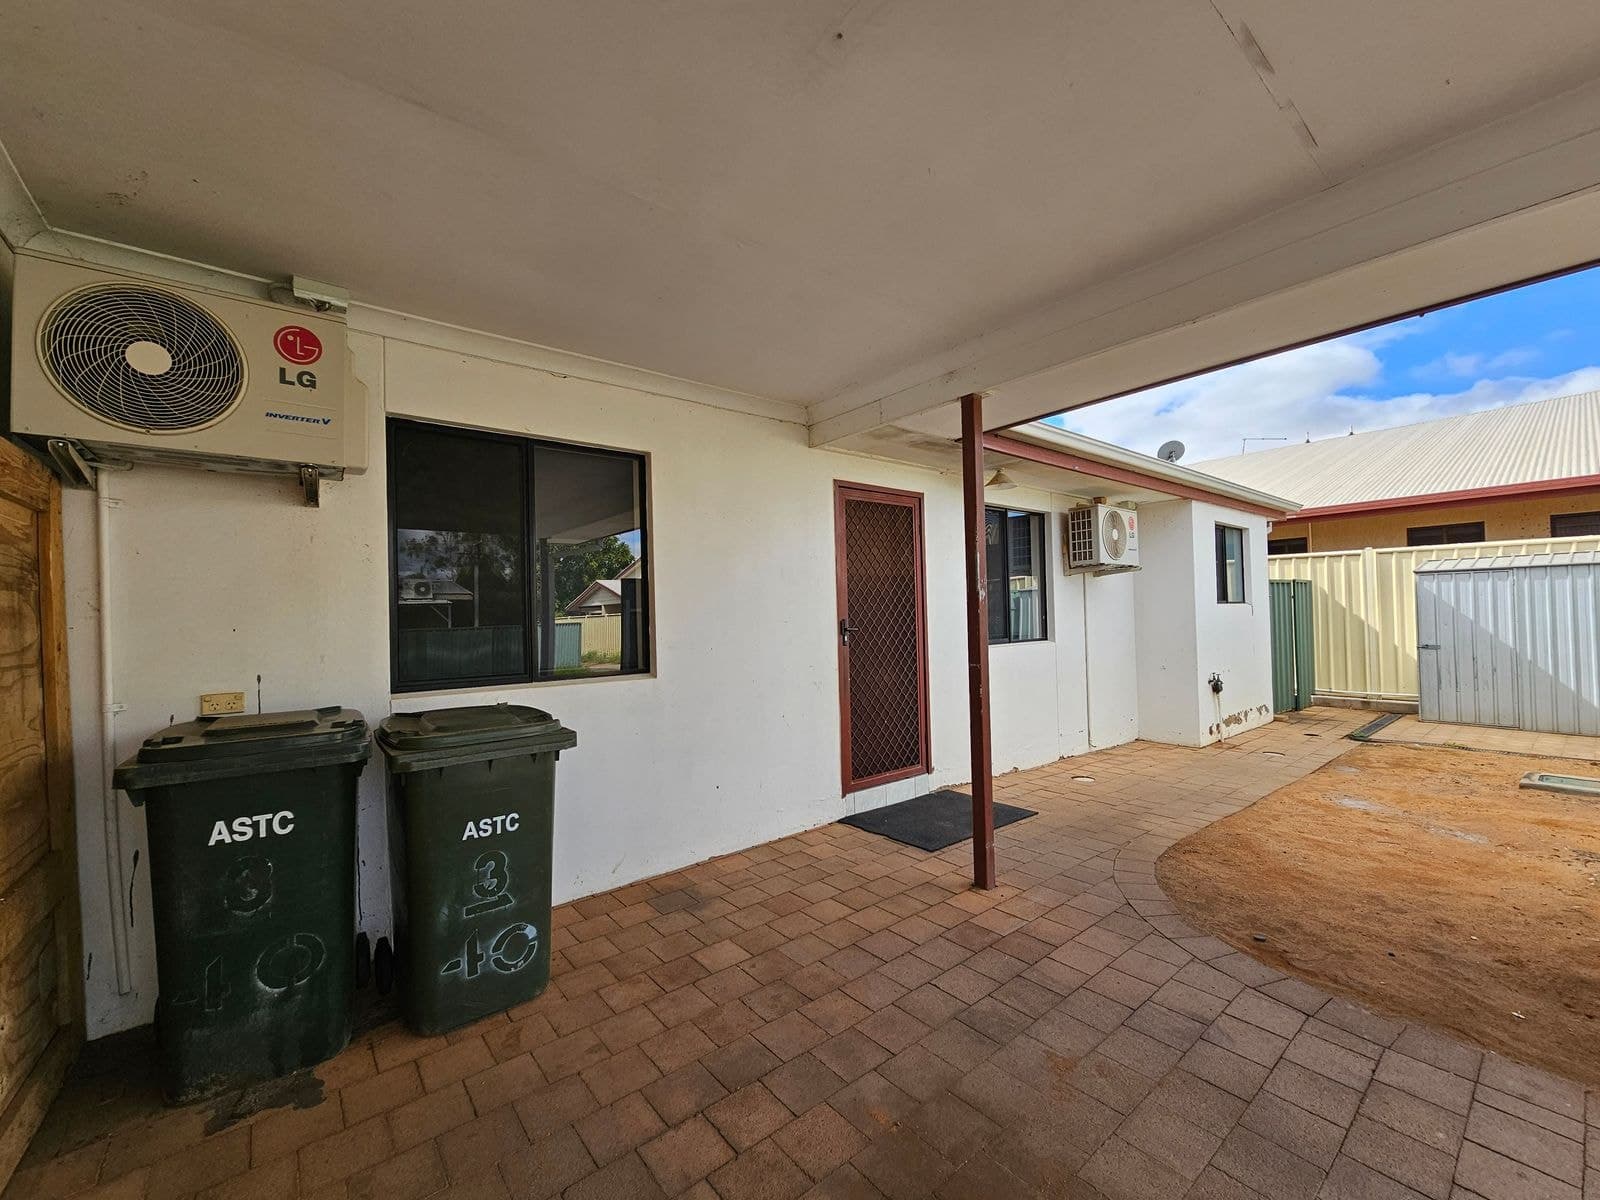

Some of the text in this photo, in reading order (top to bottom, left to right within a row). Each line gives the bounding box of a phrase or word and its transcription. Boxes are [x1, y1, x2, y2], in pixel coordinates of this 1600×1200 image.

[278, 366, 317, 389] LG
[265, 411, 320, 425] INVERTER
[208, 810, 295, 846] ASTC
[462, 813, 520, 841] ASTC
